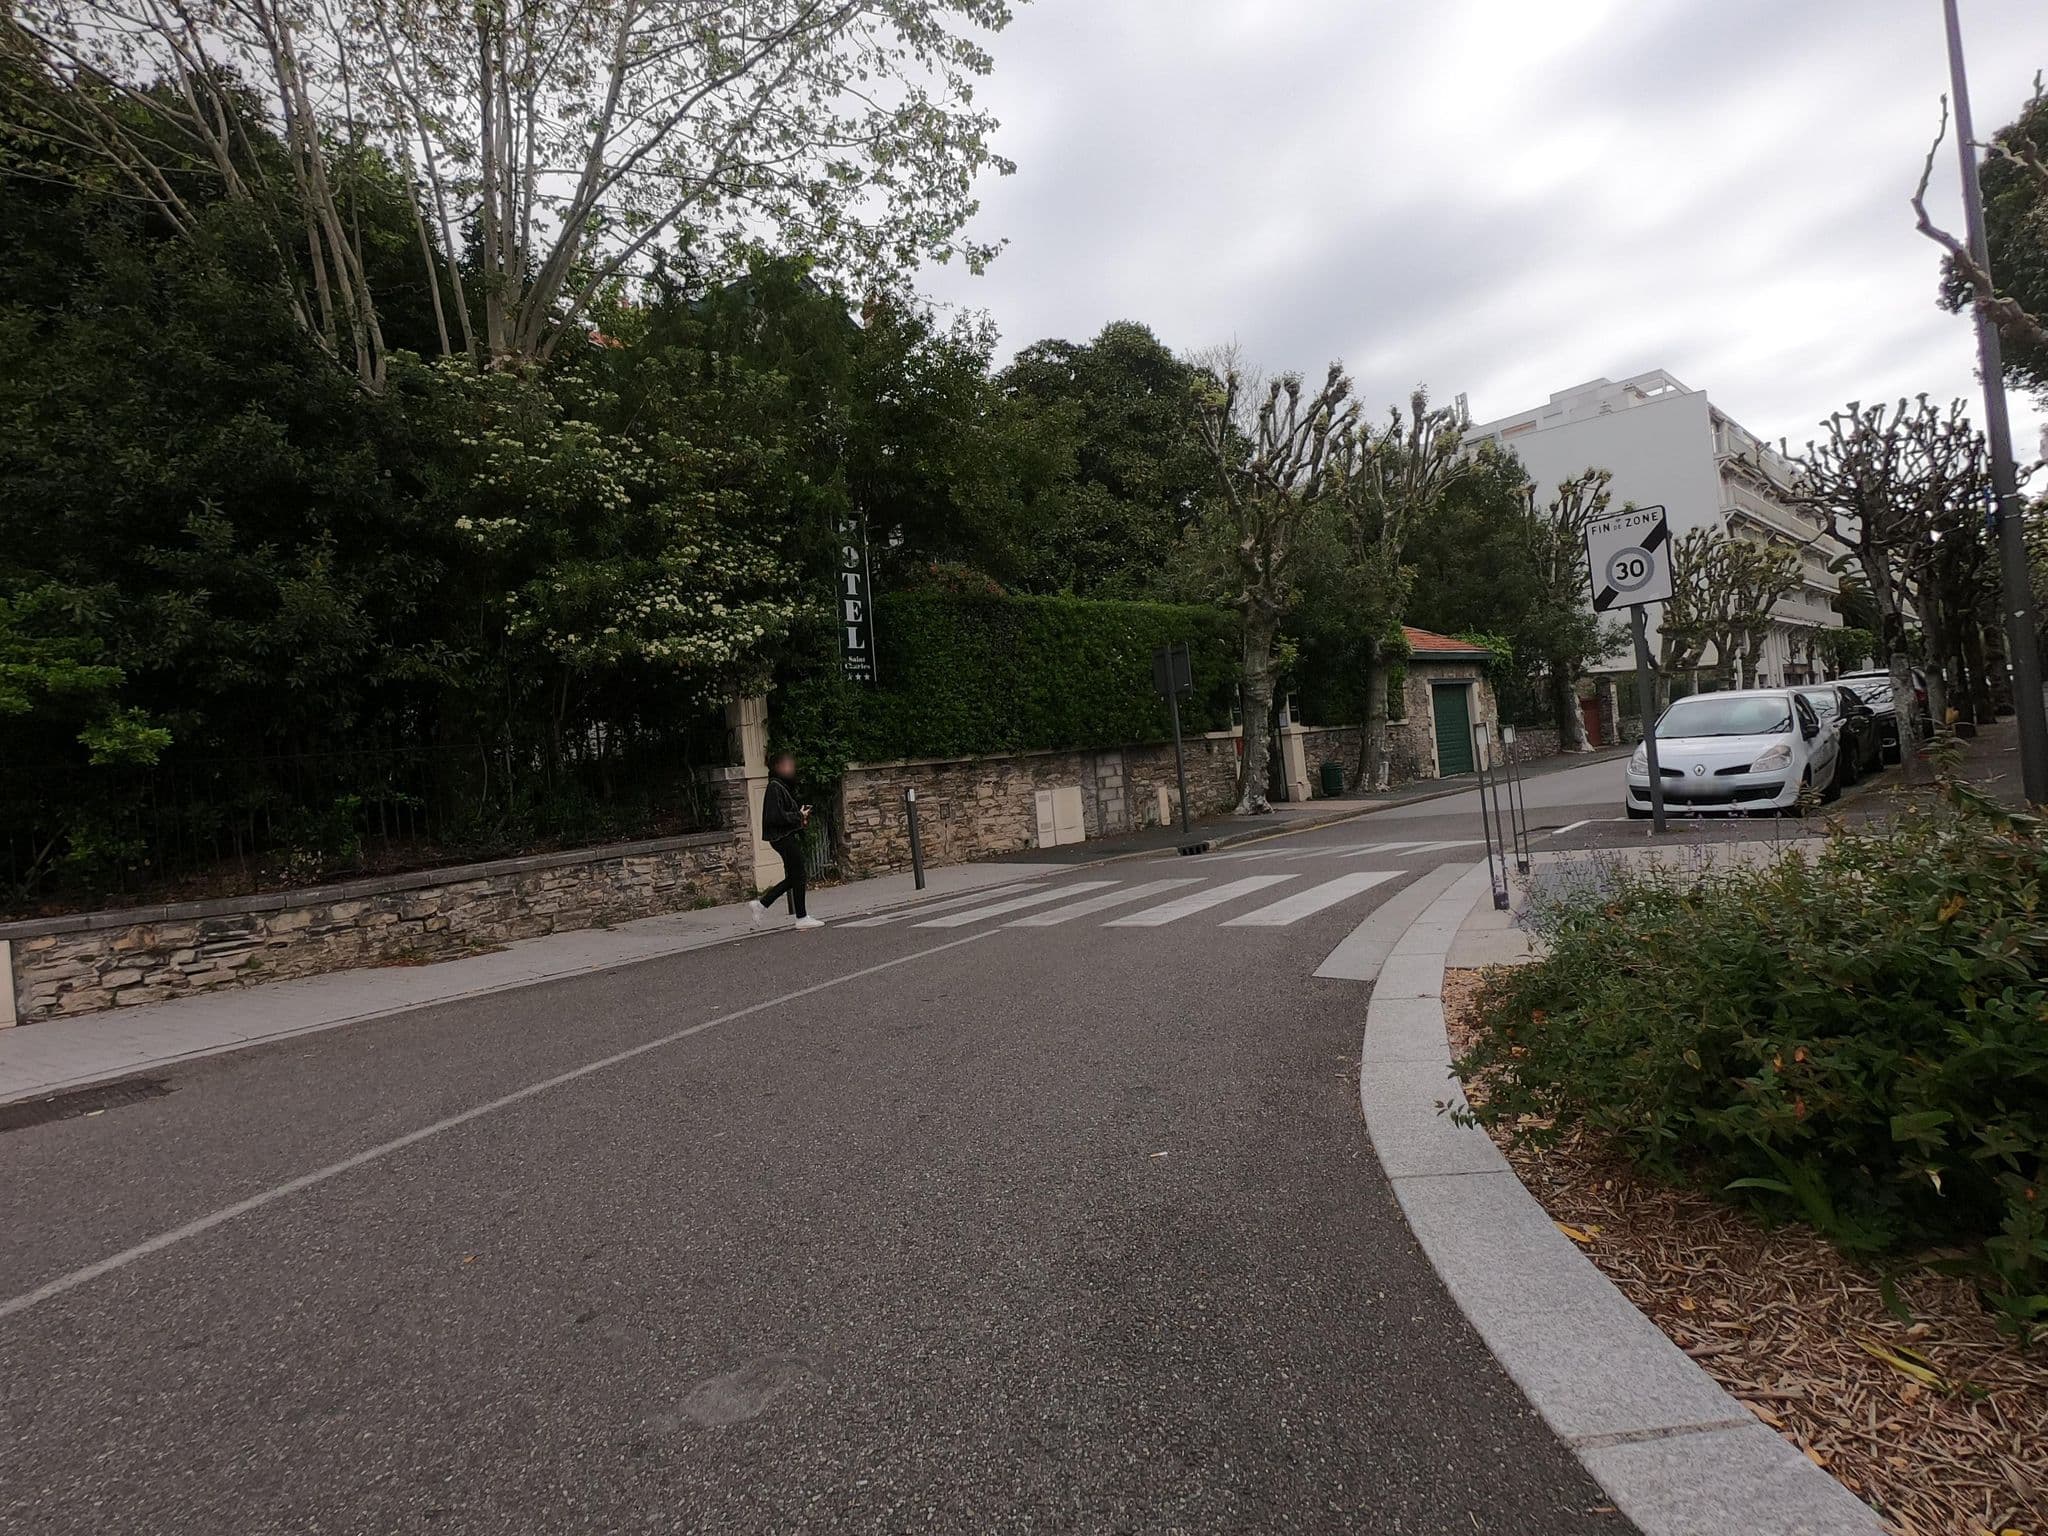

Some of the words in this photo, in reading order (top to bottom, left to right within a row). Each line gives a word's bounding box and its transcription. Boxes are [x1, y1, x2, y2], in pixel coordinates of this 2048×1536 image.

[1591, 523, 1610, 536] FIN
[1625, 511, 1659, 528] ZONE
[1615, 559, 1644, 580] 30
